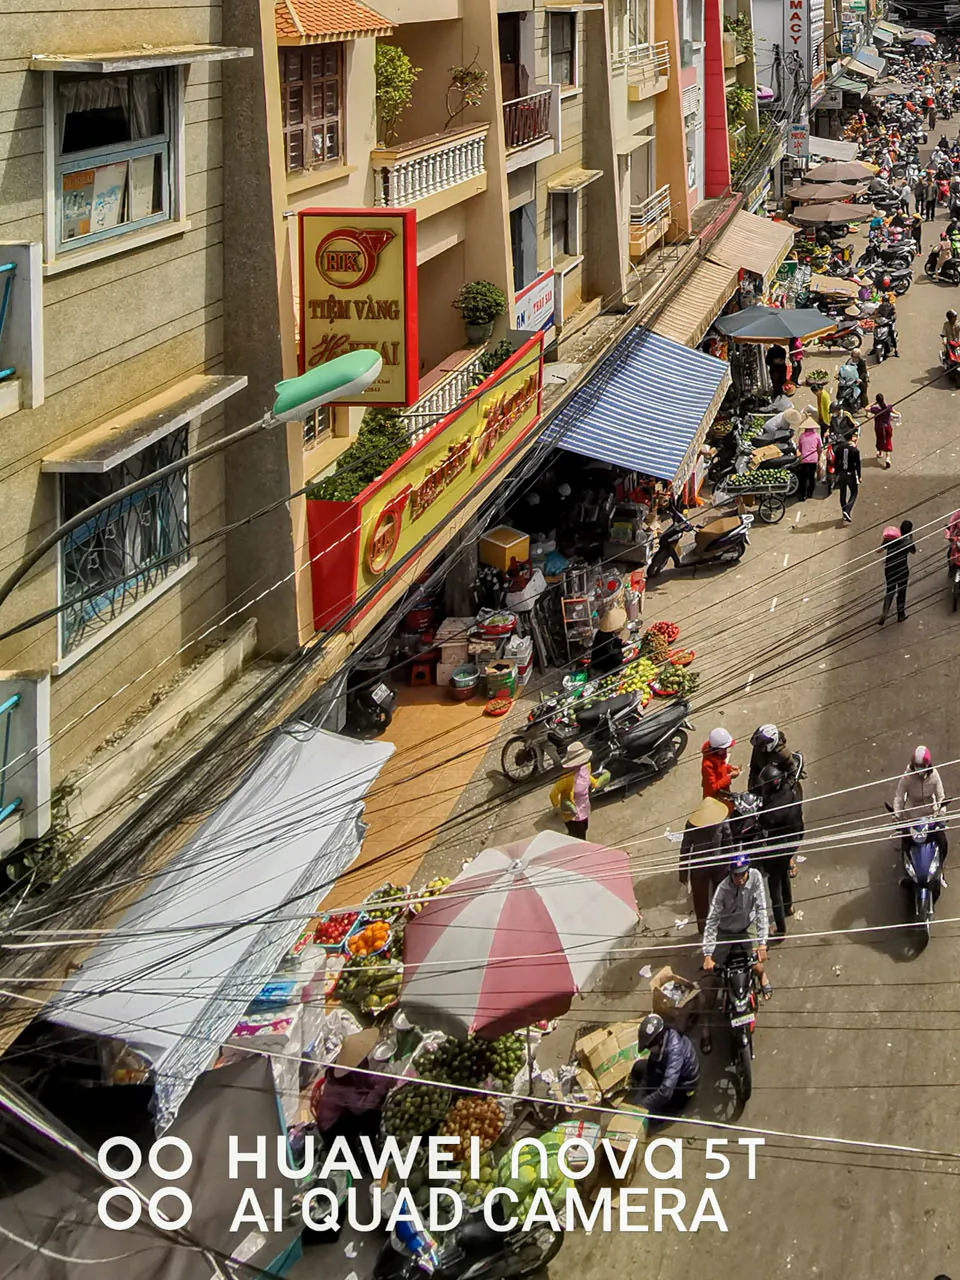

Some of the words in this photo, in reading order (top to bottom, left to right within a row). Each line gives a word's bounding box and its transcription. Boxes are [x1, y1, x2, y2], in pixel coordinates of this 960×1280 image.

[326, 252, 362, 273] HK
[309, 294, 351, 324] TIỆM
[353, 294, 400, 320] VÀNG
